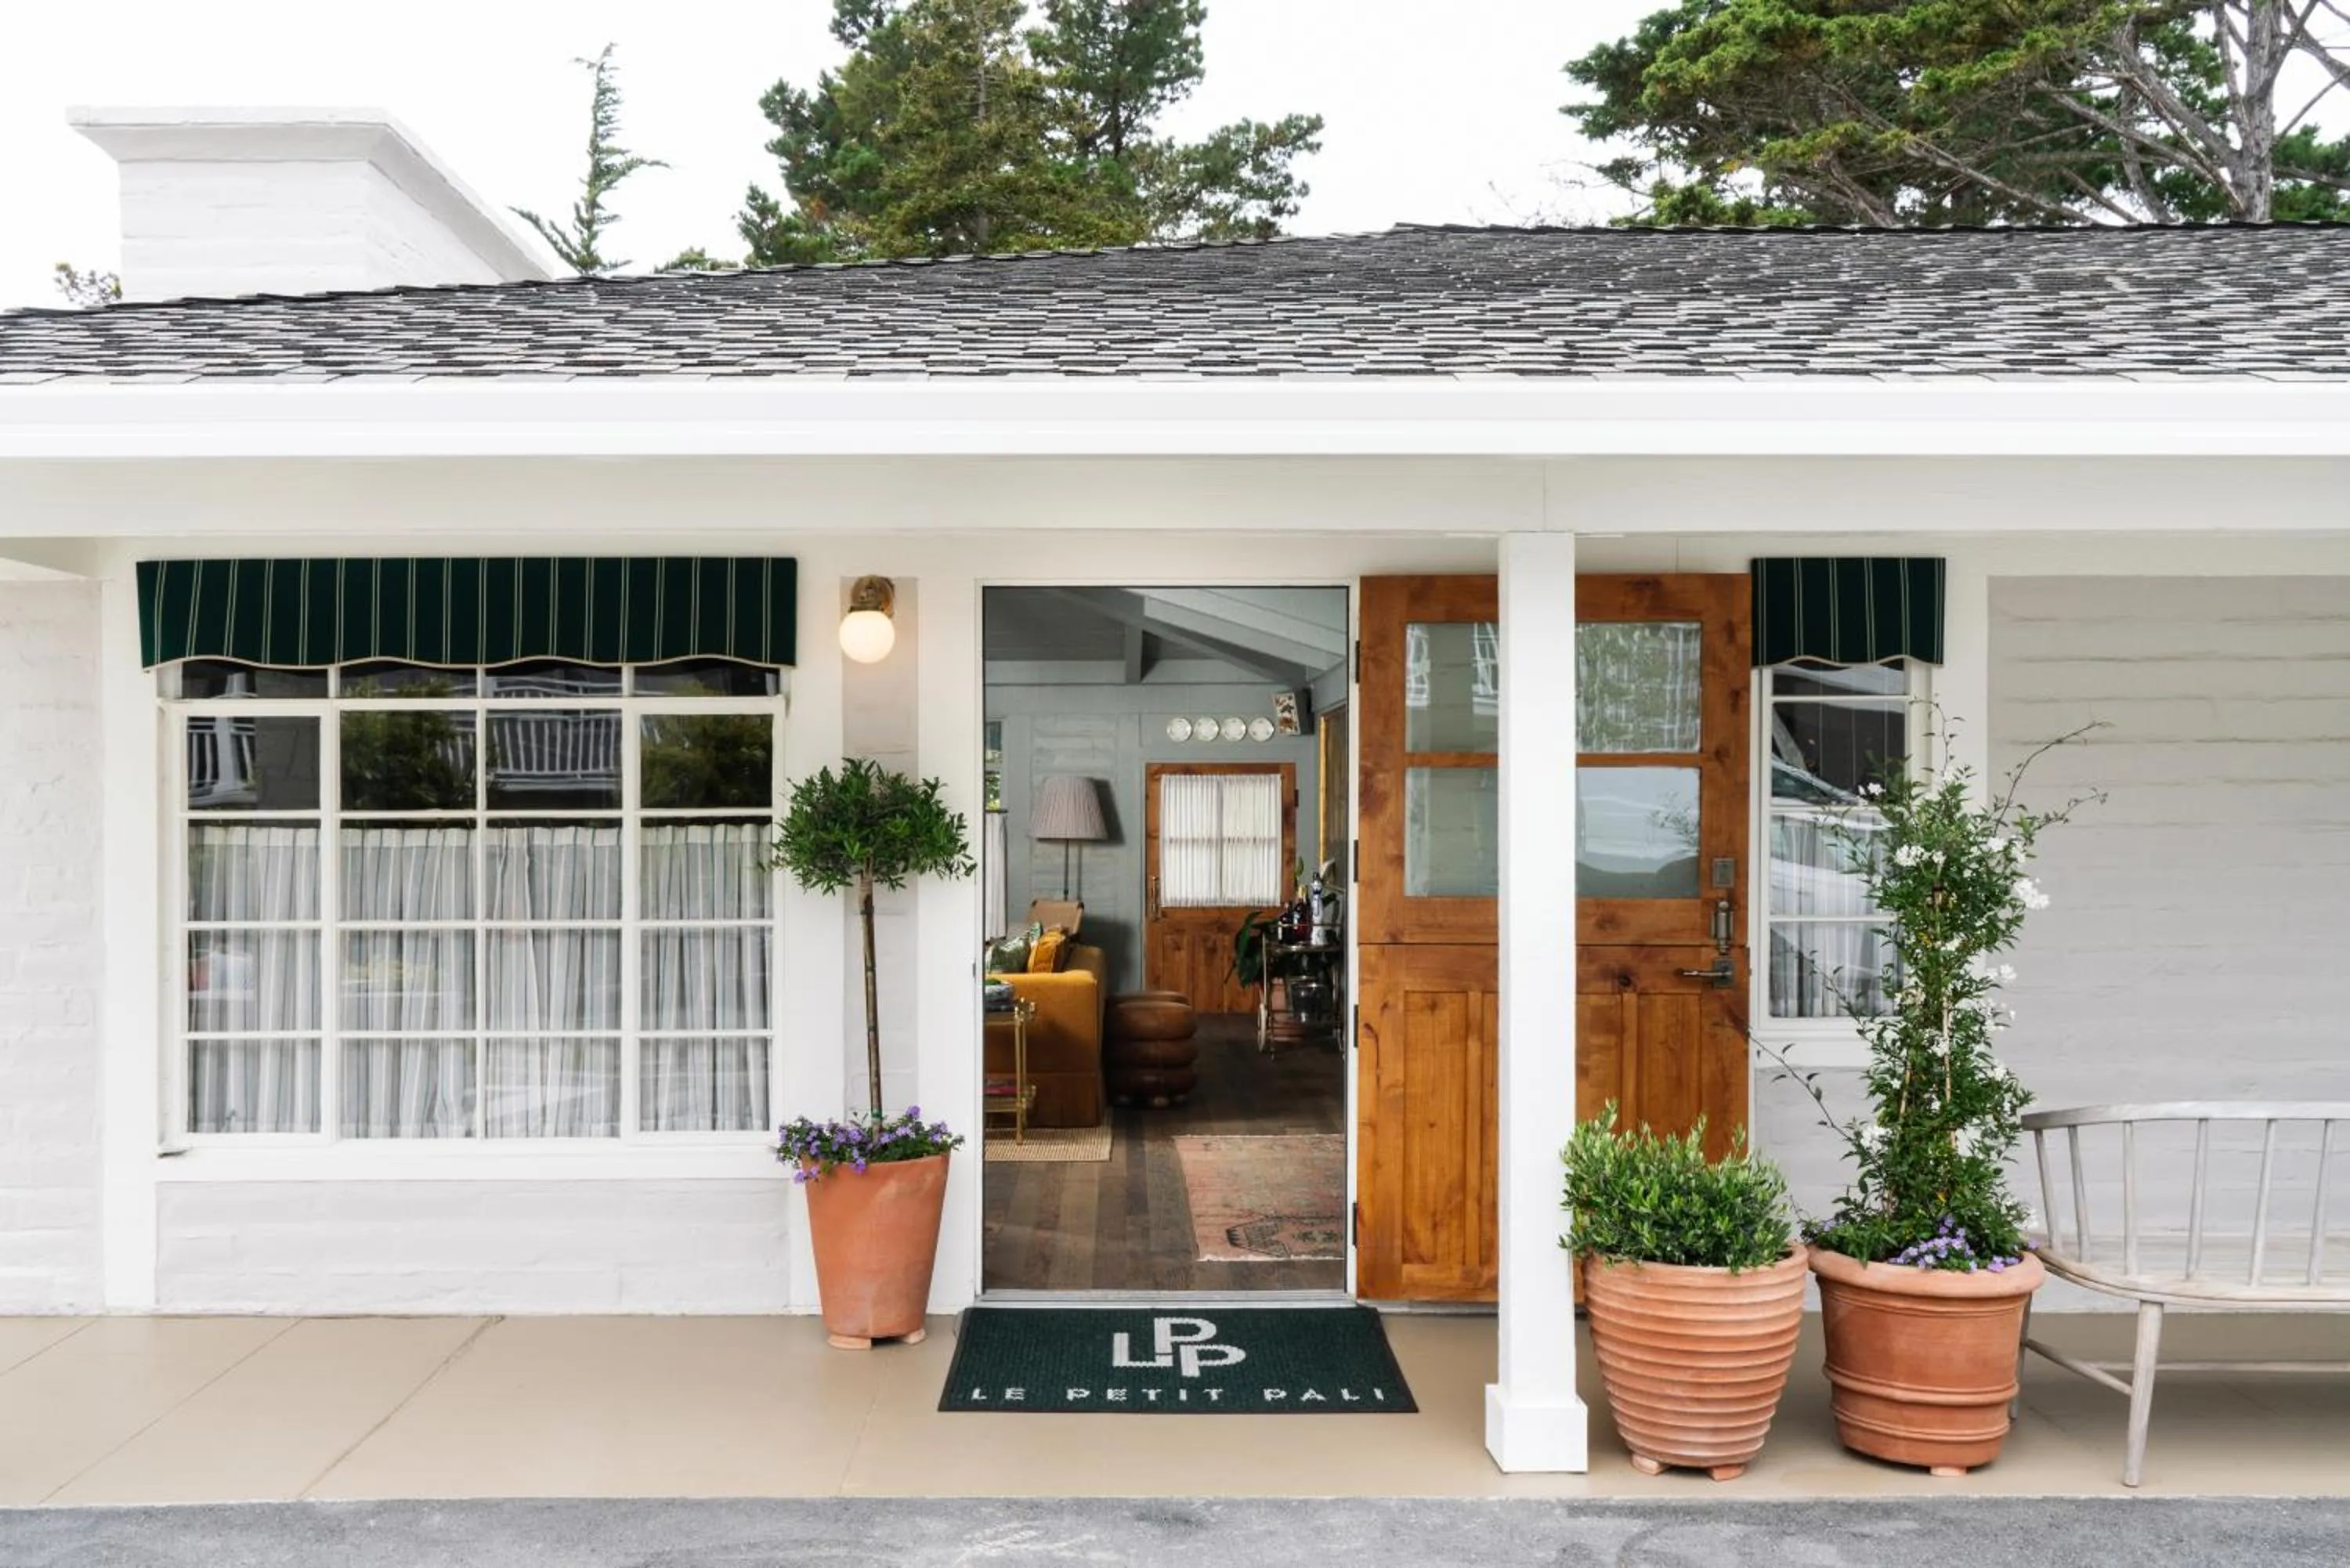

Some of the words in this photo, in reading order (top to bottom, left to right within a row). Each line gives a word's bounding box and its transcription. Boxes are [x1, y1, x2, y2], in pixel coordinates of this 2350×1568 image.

[971, 1387, 1025, 1401] LE
[1066, 1388, 1224, 1402] PETIT
[1263, 1388, 1384, 1402] PALI
